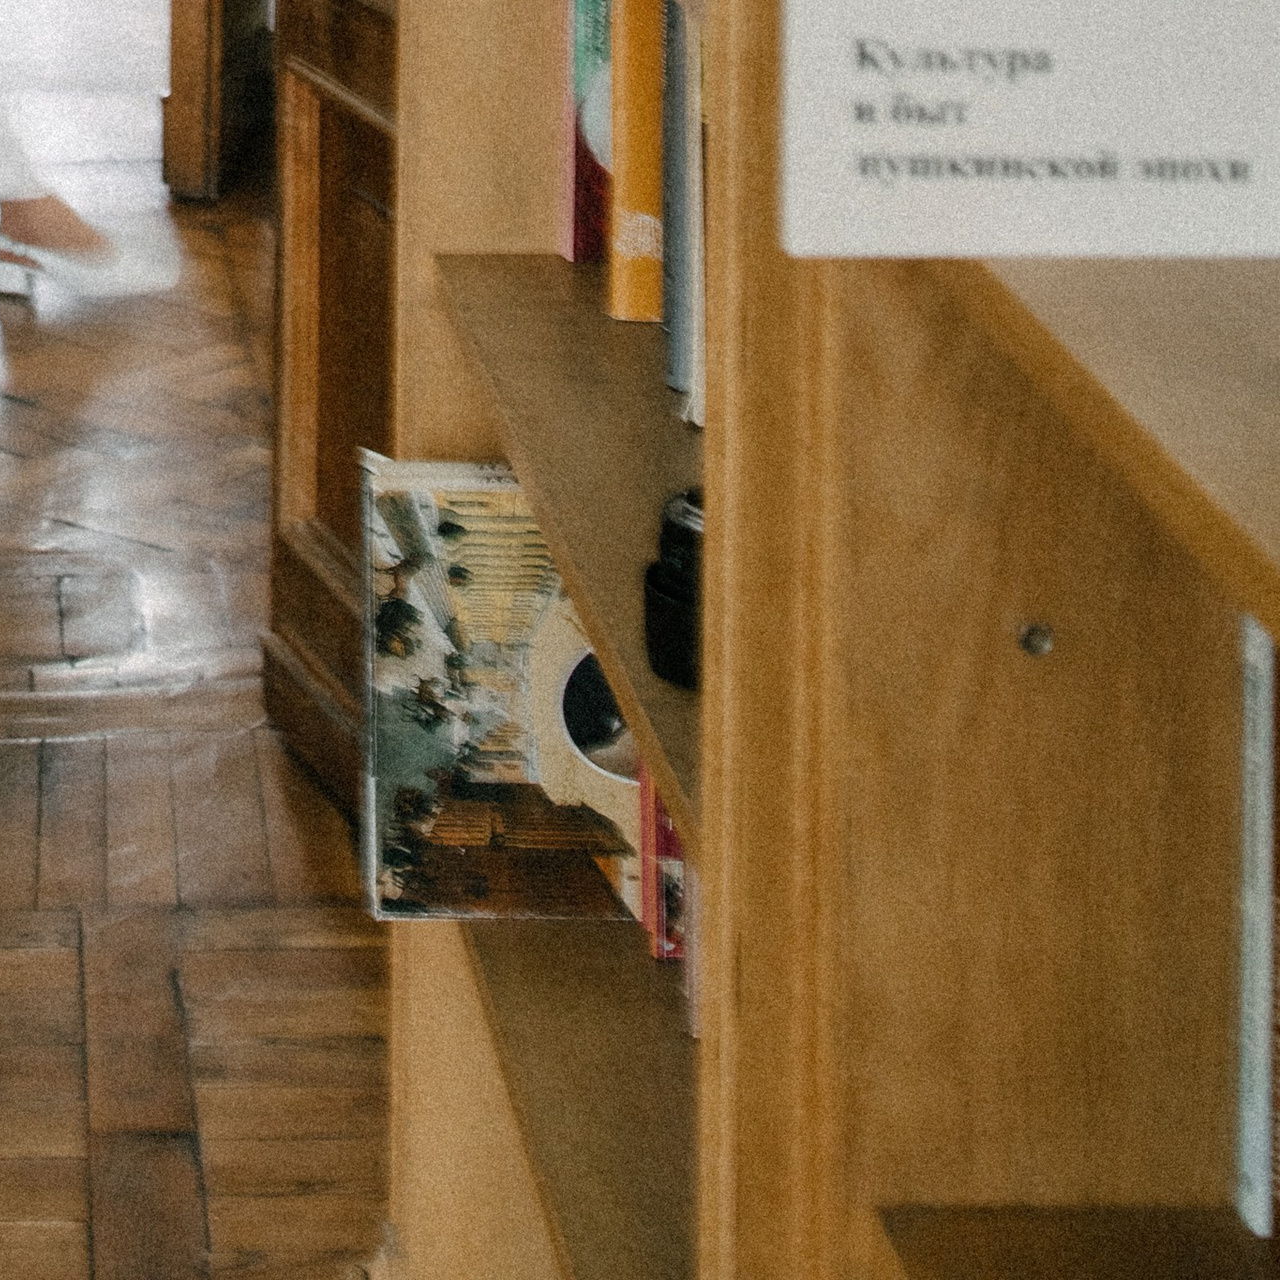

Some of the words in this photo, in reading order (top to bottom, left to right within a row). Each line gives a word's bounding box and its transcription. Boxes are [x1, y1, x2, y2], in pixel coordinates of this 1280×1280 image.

[855, 39, 1054, 84] Культура
[853, 101, 876, 124] и
[890, 92, 968, 127] быт
[858, 150, 1119, 188] пушкинской
[1139, 157, 1252, 184] эпохи
